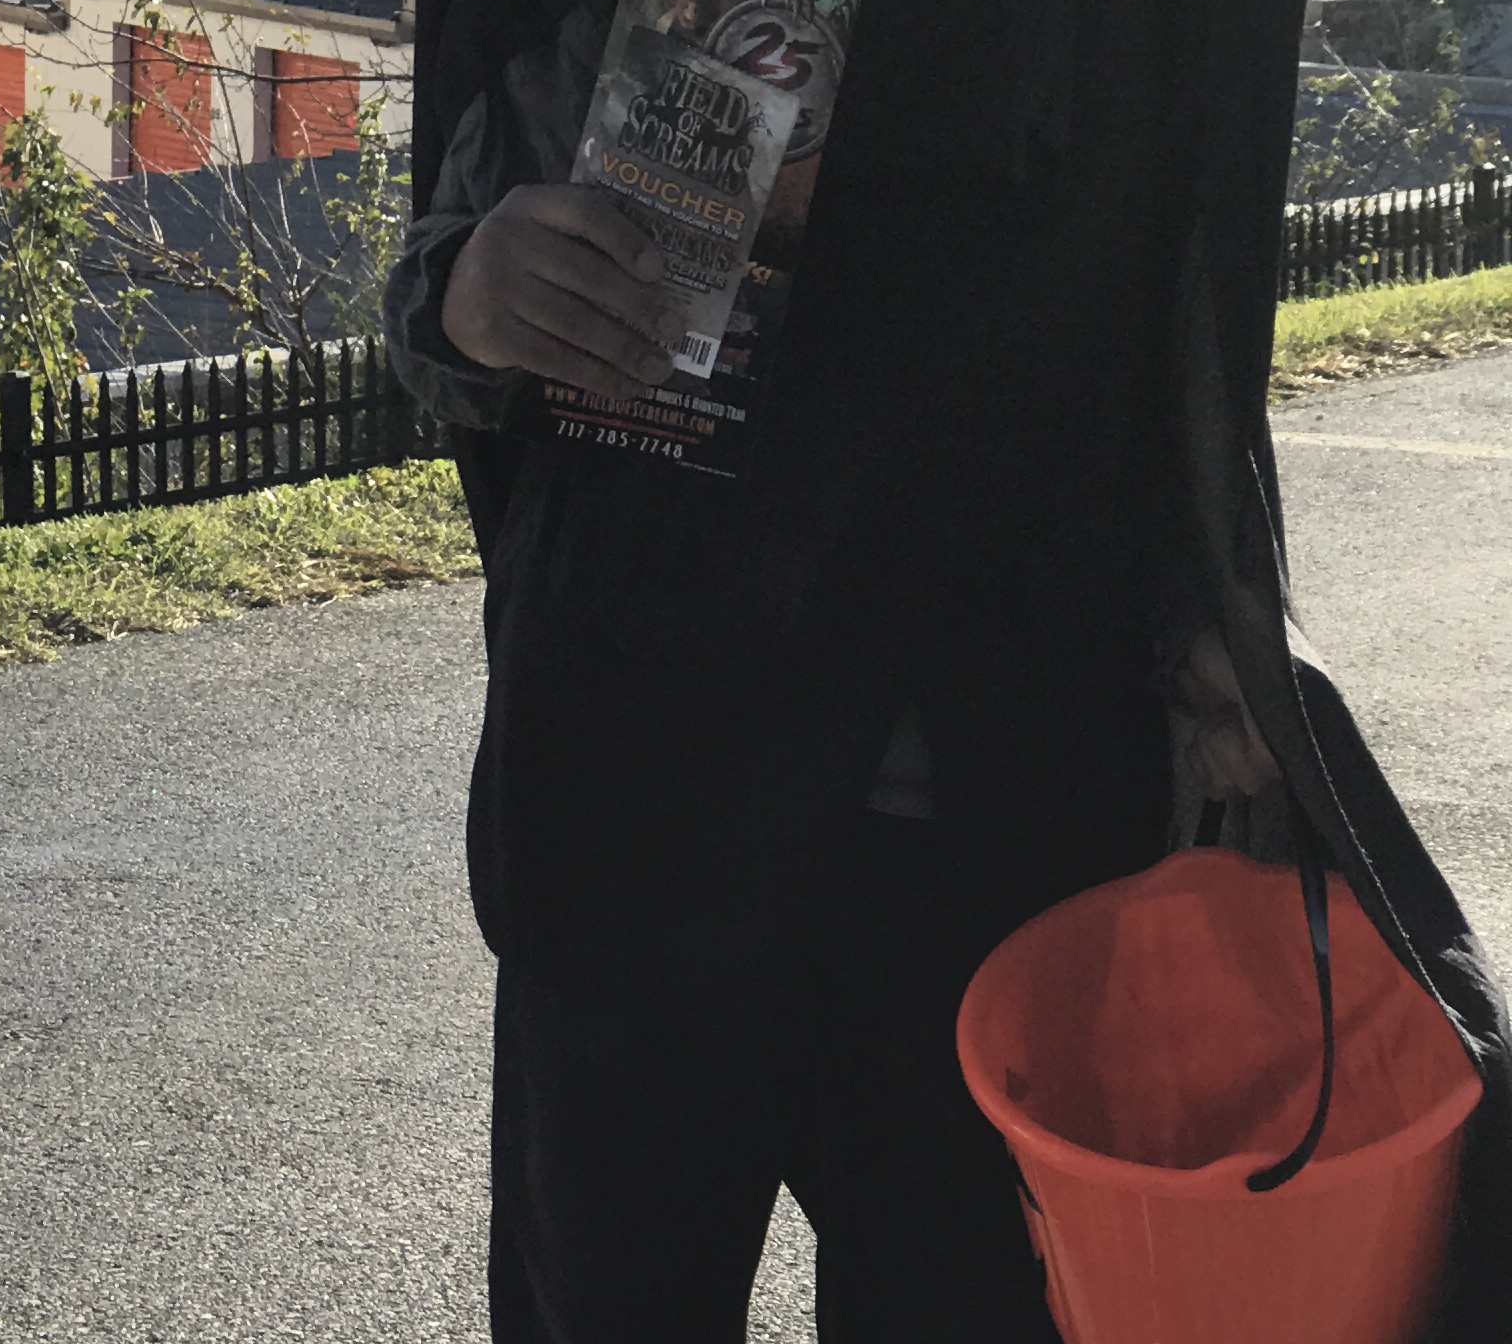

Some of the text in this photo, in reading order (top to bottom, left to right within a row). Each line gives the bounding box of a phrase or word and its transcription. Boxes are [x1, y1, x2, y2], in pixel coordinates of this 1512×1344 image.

[657, 61, 750, 136] FIELD
[678, 109, 703, 137] OF
[623, 95, 753, 195] SCREAMS
[601, 151, 747, 232] VOUCHER
[669, 261, 727, 288] CENTER
